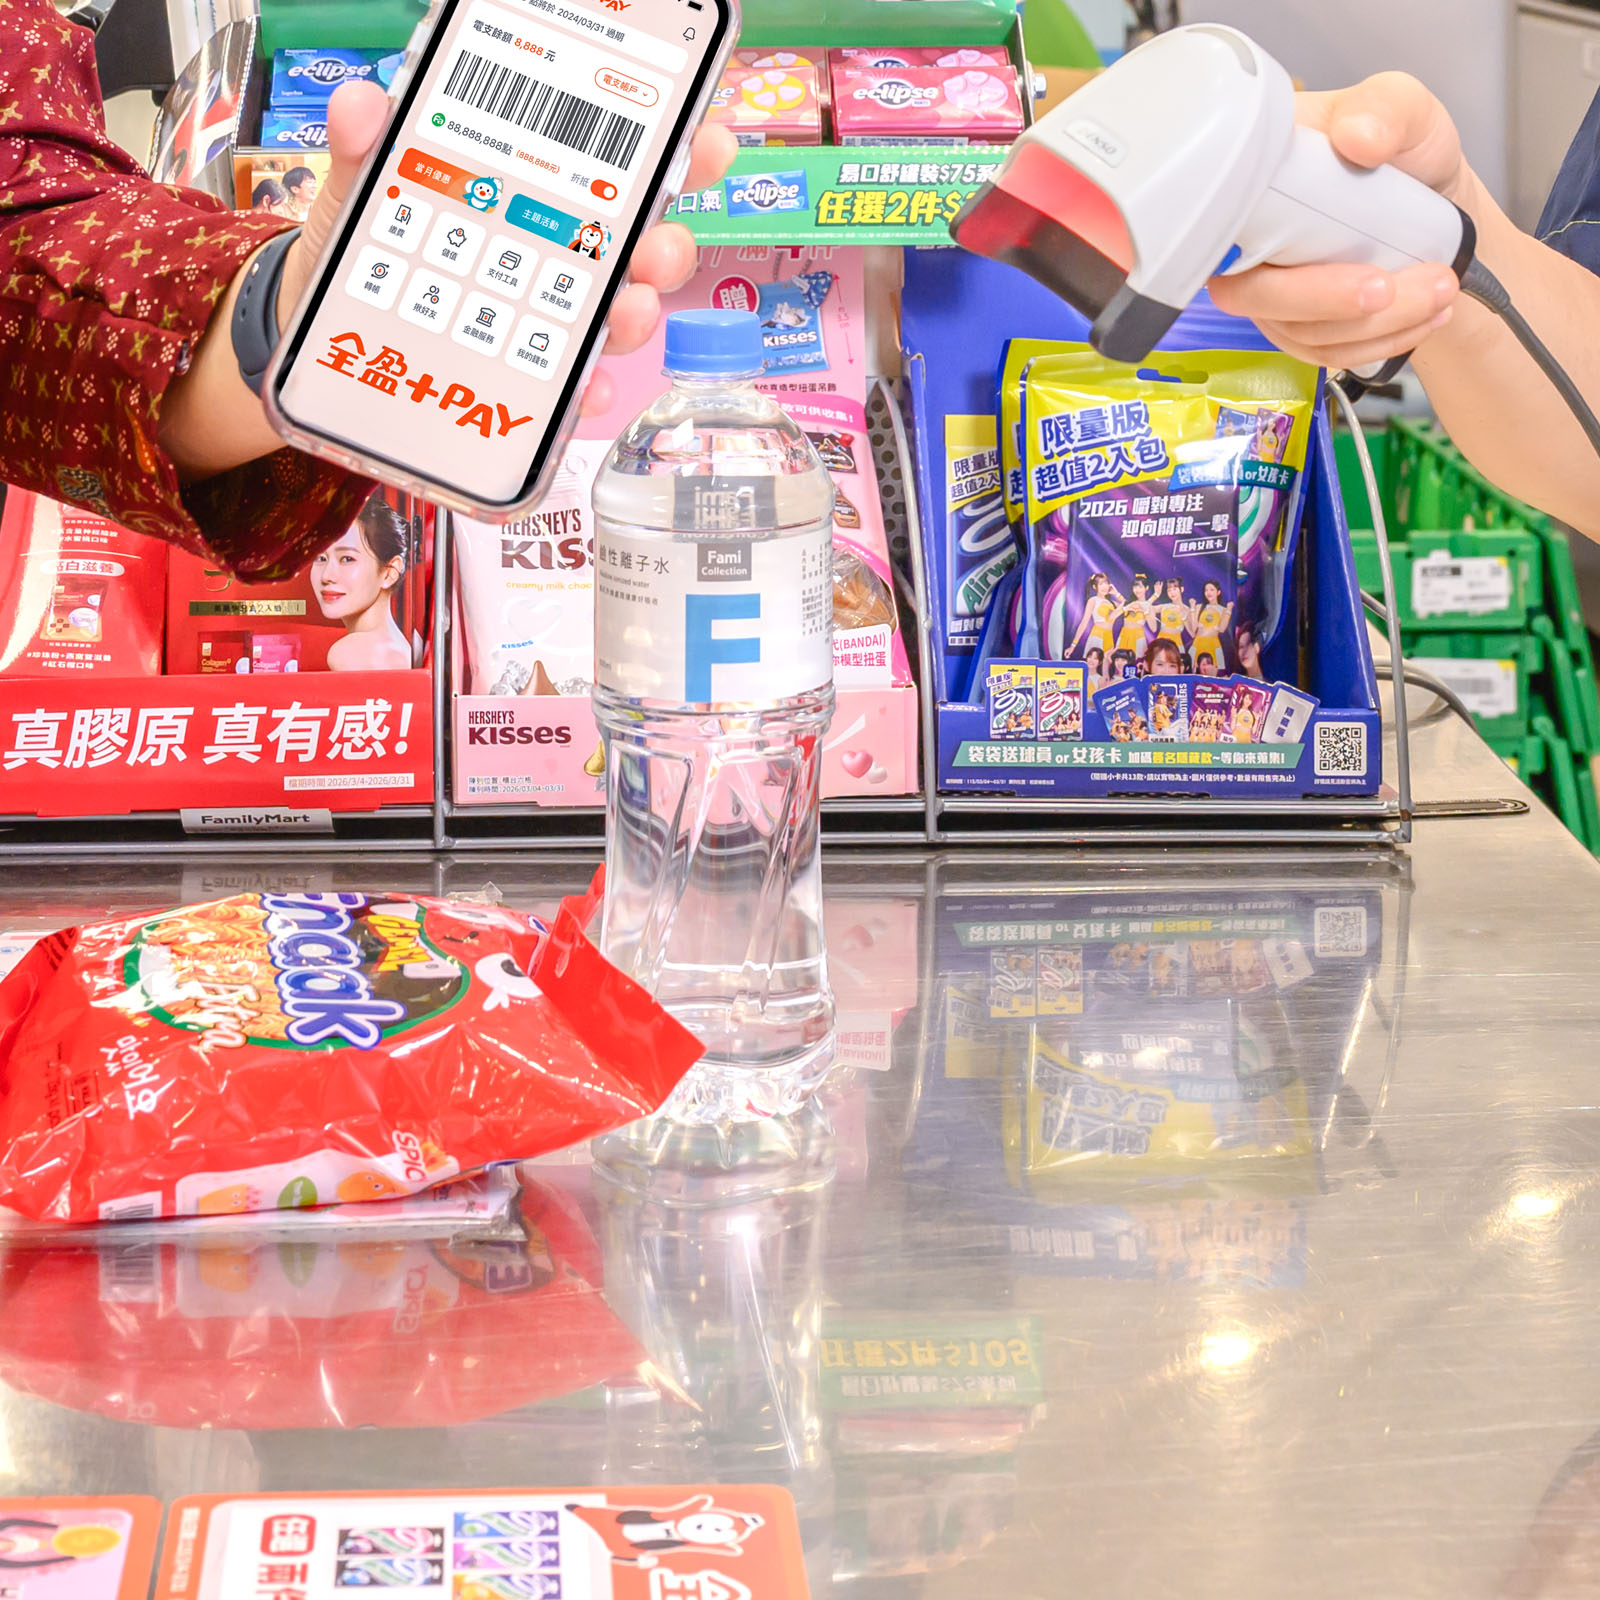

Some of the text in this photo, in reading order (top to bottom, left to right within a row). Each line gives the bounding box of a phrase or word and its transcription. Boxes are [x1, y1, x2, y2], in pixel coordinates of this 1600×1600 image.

[557, 8, 606, 33] 2024/03/31
[605, 27, 625, 42] 過期
[472, 19, 557, 62] 電支餘額 8,888 元
[288, 61, 372, 83] eclipse
[602, 73, 639, 94] 電支帳戶
[853, 80, 938, 104] eclipse
[447, 120, 561, 174] 88,888,888點 (888,888元)
[414, 162, 452, 184] 當月優惠
[570, 172, 590, 188] 折抵
[839, 163, 1005, 187] 易口舒罐裝$75系
[665, 189, 723, 216] 口氣
[732, 178, 799, 209] eclipse
[817, 190, 977, 226] 任選2件$
[521, 207, 560, 232] 主題活動
[387, 224, 406, 239] 繳費
[441, 247, 459, 262] 儲值
[363, 280, 381, 295] 轉帳
[487, 267, 519, 288] 支付工具
[539, 289, 573, 311] 交易紀錄
[462, 324, 496, 346] 金融服務
[516, 347, 550, 369] 我的錢包
[316, 331, 534, 439] 全盈+PAY
[1041, 401, 1148, 452] 限量版
[1035, 437, 1166, 494] 超值2入包
[1257, 466, 1291, 486] 女孩卡
[1079, 494, 1204, 518] 2026 嚼對專注
[1121, 514, 1230, 539] 迎向關鍵一擊
[708, 550, 741, 565] Fami
[1179, 540, 1224, 553] 經典女孩卡
[701, 566, 748, 577] Collection
[505, 582, 543, 591] creamy
[546, 581, 565, 590] milk
[685, 593, 761, 703] F
[468, 710, 514, 725] HERSHEY'S
[2, 698, 415, 771] 真膠原 真有感!
[468, 726, 572, 745] KISSES
[968, 746, 1052, 764] 袋袋送球員
[1055, 753, 1069, 764] or
[1072, 747, 1122, 764] 女孩卡
[327, 775, 410, 787] 2026/3/4-2026/3/31
[201, 813, 311, 826] FamilyMart
